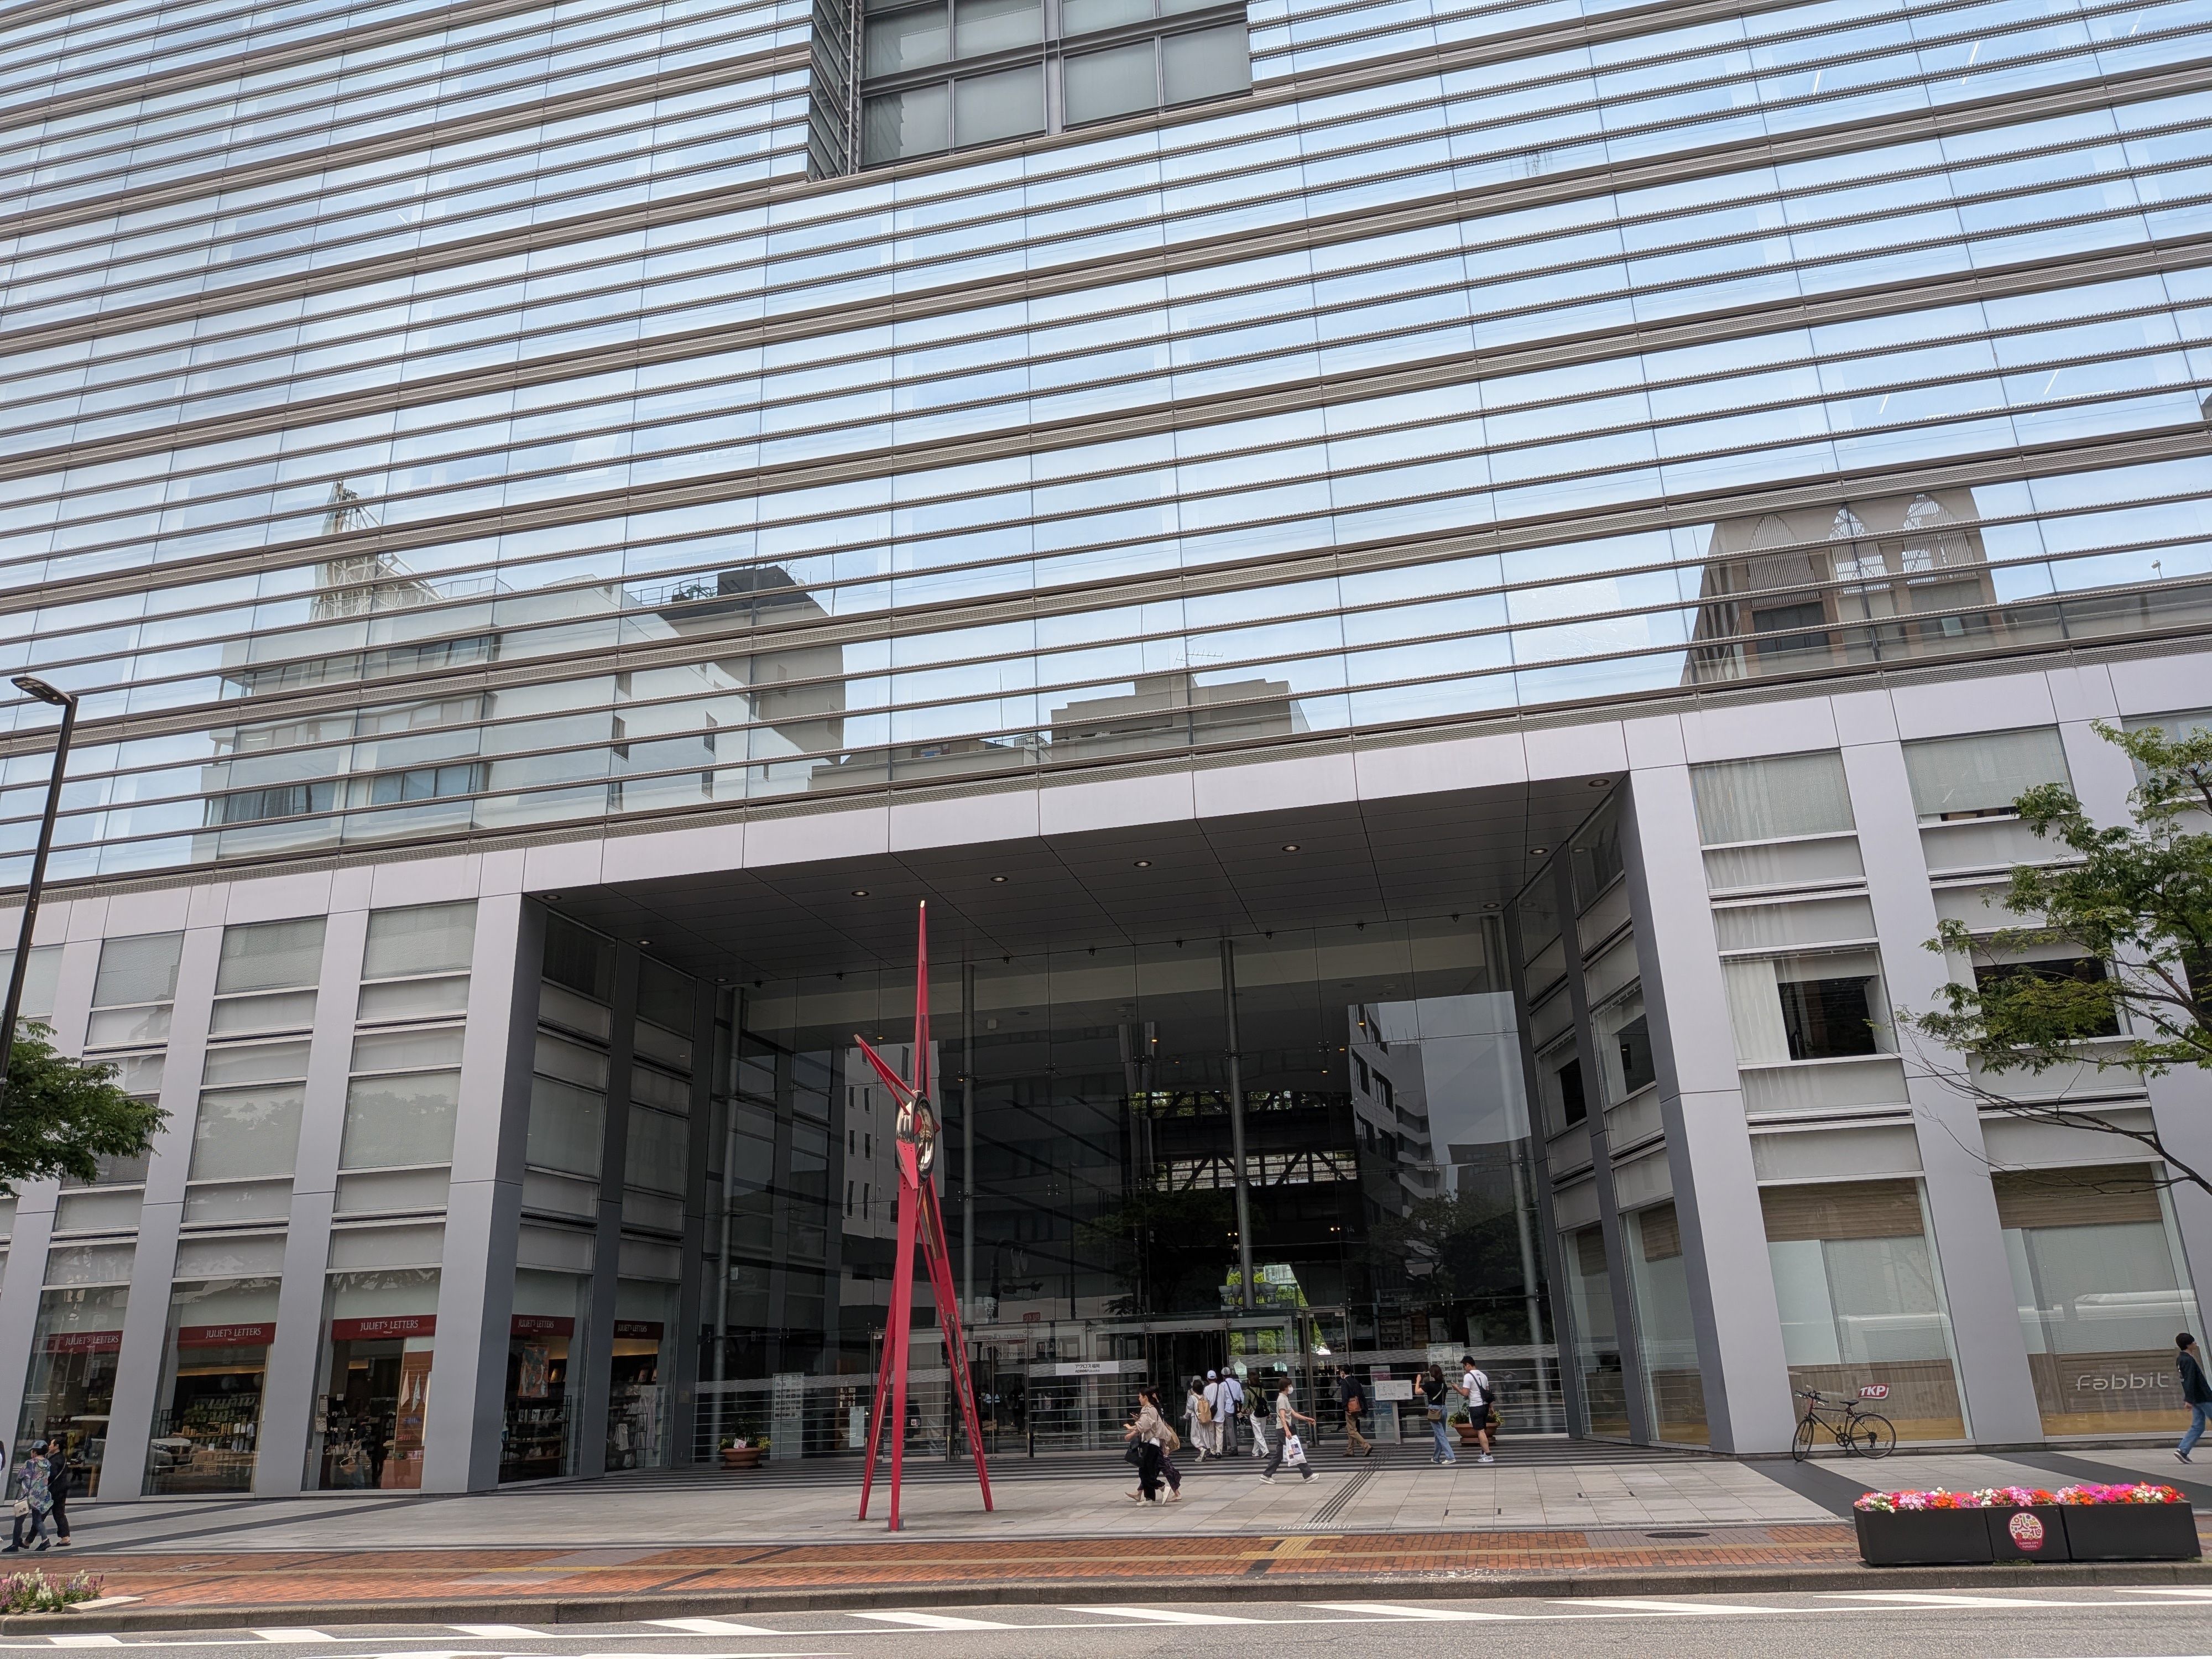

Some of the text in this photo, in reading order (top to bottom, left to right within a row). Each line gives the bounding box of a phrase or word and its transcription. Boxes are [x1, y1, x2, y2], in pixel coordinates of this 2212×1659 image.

[390, 1319, 419, 1329] LETTERS
[234, 1327, 262, 1337] LETTERS
[92, 1335, 119, 1344] LETTERS
[2075, 1371, 2169, 1391] fabbit
[1860, 1385, 1886, 1396] TKP
